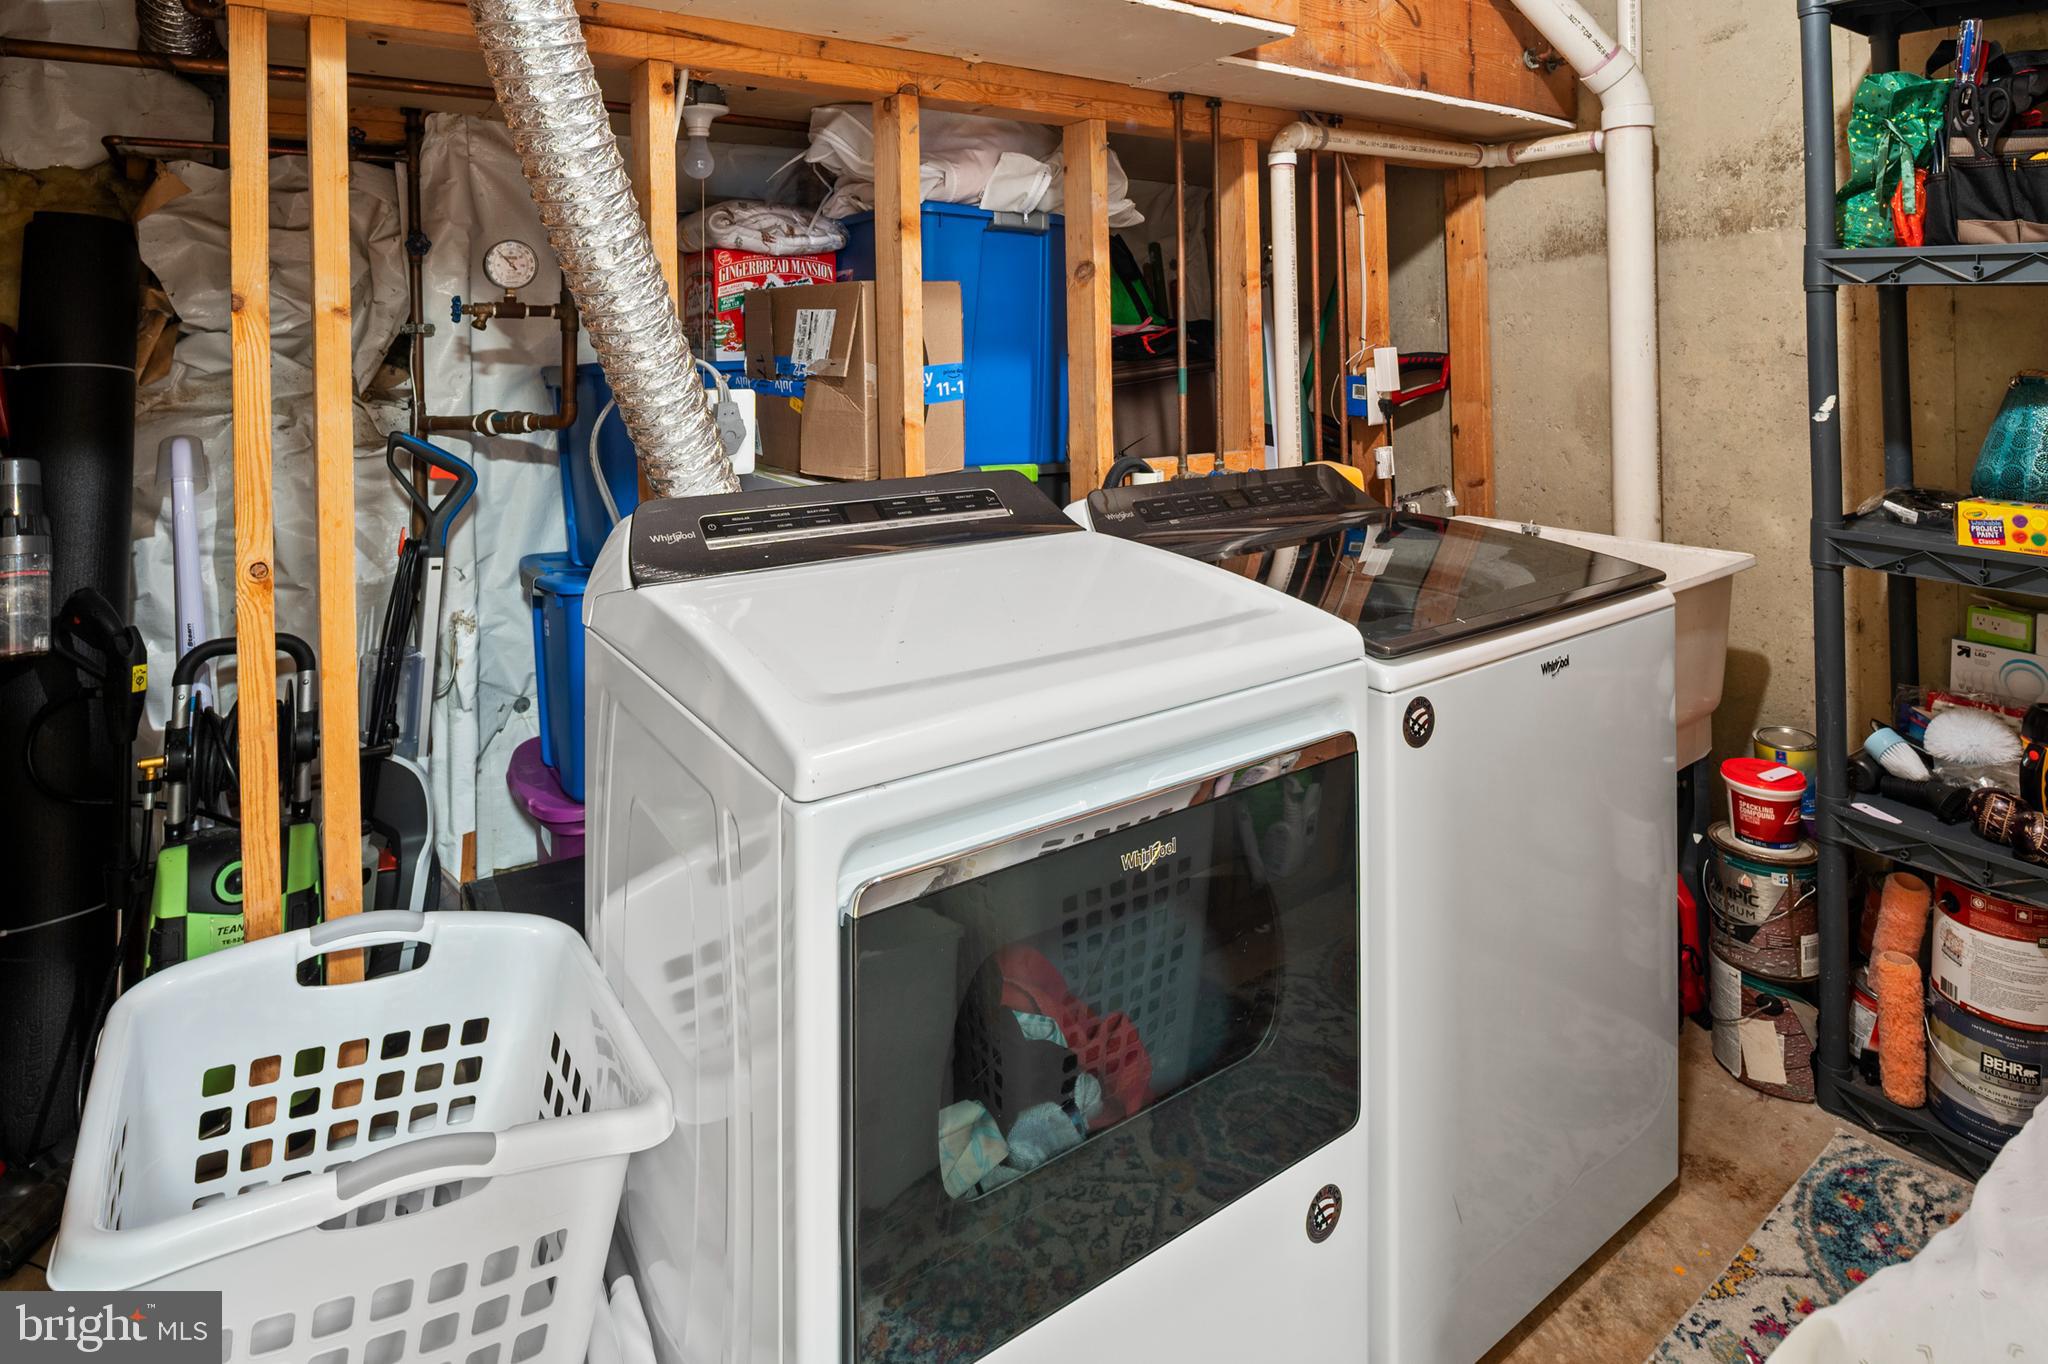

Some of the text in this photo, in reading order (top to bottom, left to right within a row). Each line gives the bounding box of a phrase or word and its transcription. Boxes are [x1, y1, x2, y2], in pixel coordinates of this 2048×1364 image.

[1568, 14, 1581, 27] NOT
[1581, 26, 1593, 39] FOR
[718, 259, 833, 283] GINGERBREAD MANSION
[775, 380, 793, 392] July
[1105, 511, 1135, 522] Whirlpool
[649, 531, 696, 545] Whirlpool
[1541, 654, 1570, 677] Whirlpool
[1738, 800, 1774, 814] SPACKLING
[1739, 806, 1776, 821] COMPOUND
[1120, 836, 1177, 872] Whirlpool
[1982, 1065, 2039, 1085] PREMIUM PLUS
[1983, 1053, 2024, 1077] BEHR
